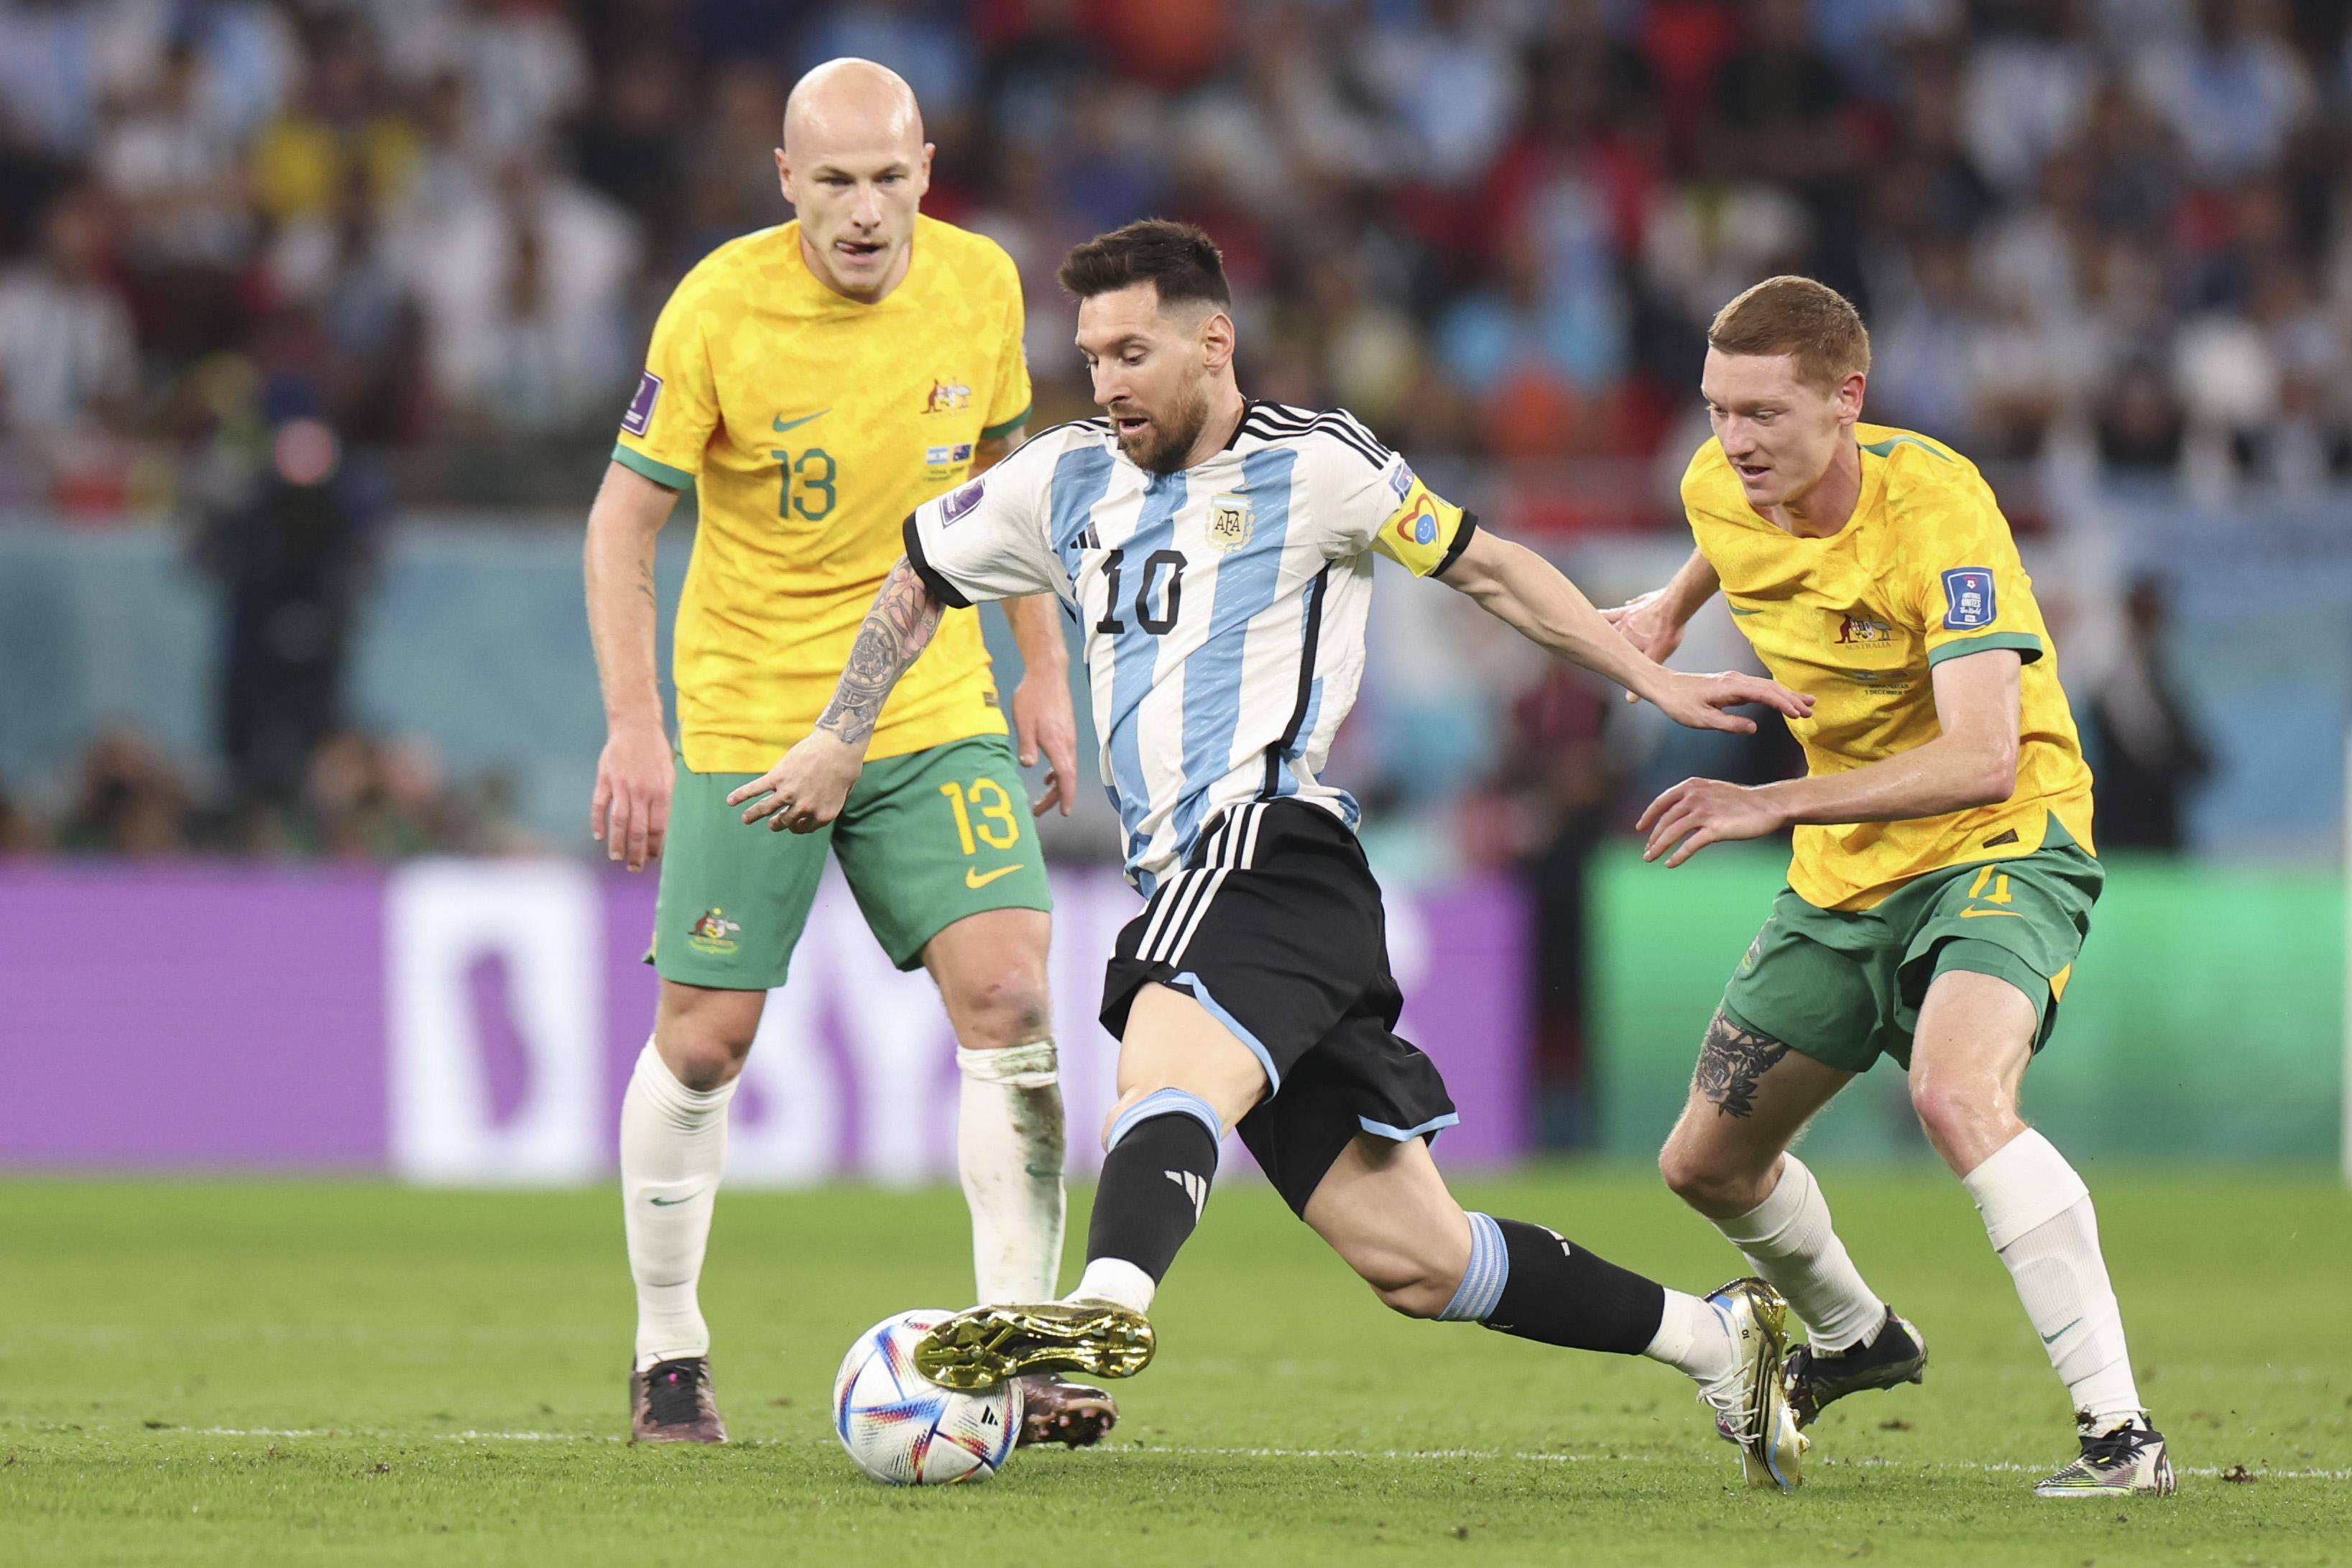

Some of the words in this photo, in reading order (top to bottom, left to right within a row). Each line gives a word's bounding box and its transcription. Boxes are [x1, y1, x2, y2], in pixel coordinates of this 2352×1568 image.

[772, 448, 836, 521] 13
[1214, 509, 1240, 536] AFA
[1097, 550, 1188, 635] 10
[1845, 642, 1891, 650] AUSTRALIA
[939, 777, 1020, 855] 13
[1968, 864, 2012, 904] 4
[1741, 1329, 1750, 1339] 10
